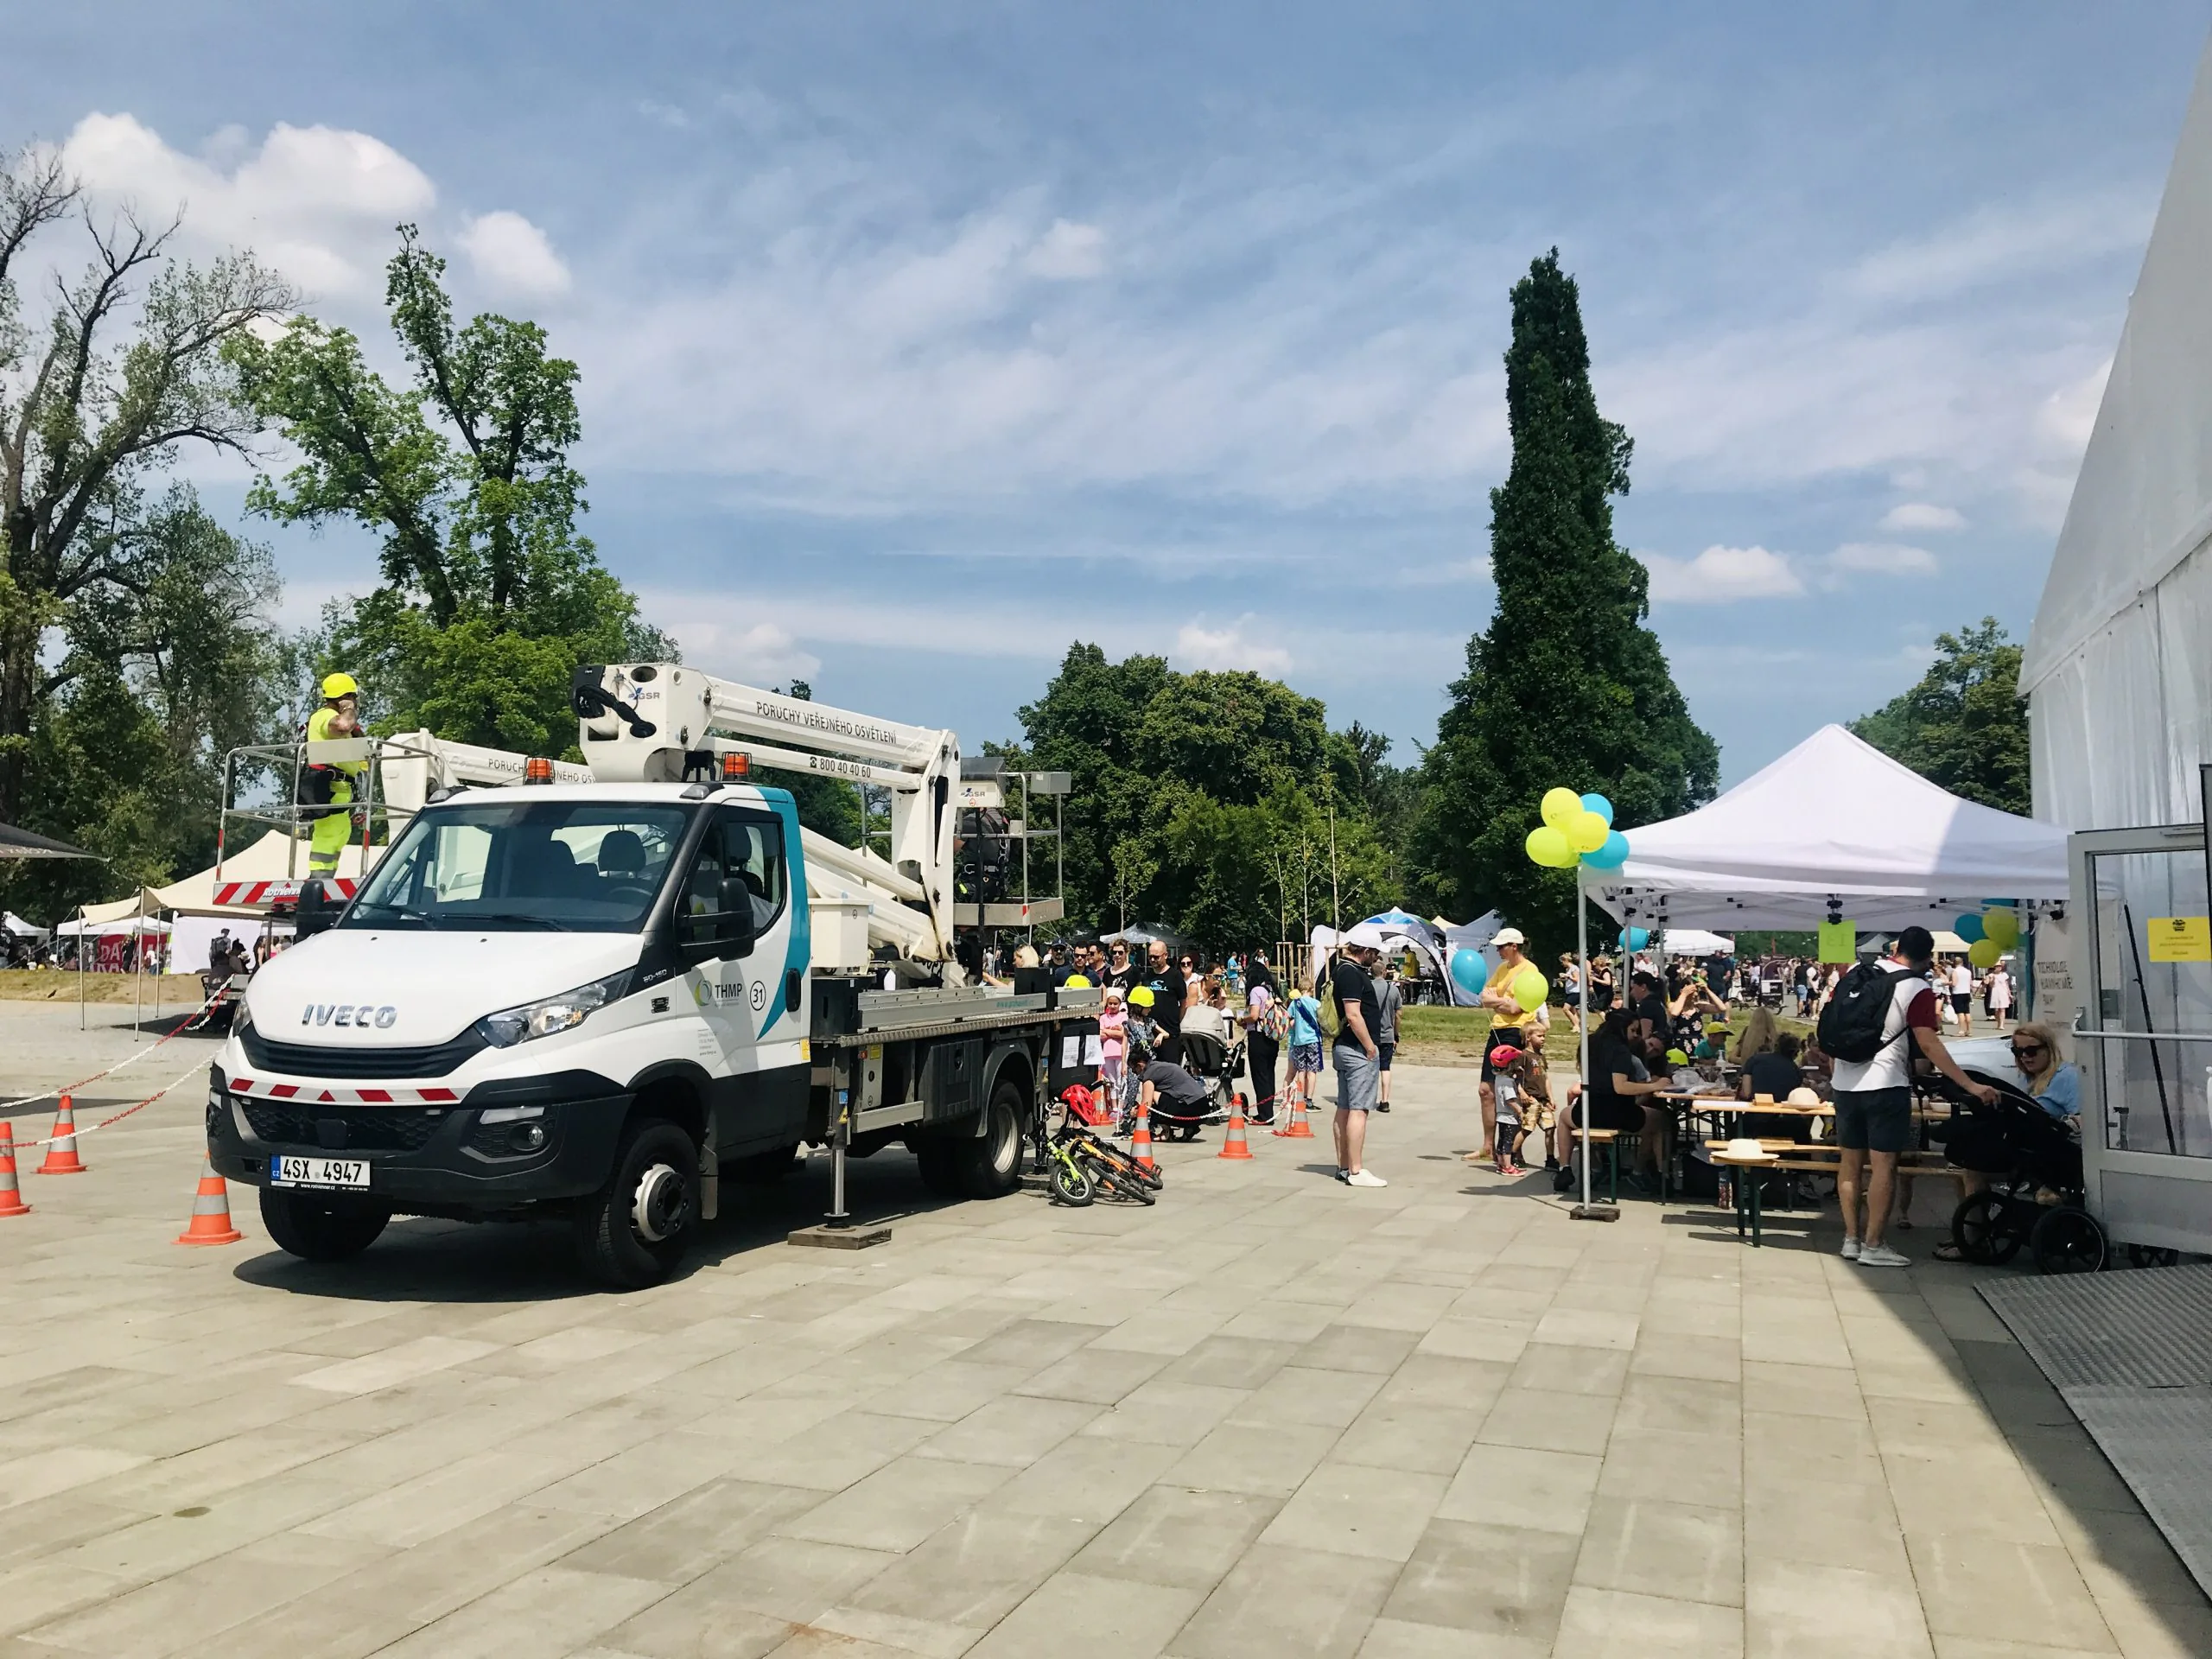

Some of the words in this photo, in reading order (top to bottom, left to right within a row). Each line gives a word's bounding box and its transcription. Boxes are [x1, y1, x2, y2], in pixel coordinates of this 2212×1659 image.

[756, 702, 801, 723] PORUCHY
[804, 712, 853, 735] VEŘEJNÉHO
[855, 725, 897, 745] OSVĚTLENÍ
[488, 759, 524, 772] PORUCH
[820, 758, 836, 772] 800
[837, 761, 848, 774] 40
[849, 764, 860, 776] 40
[861, 766, 871, 779] 60
[263, 887, 301, 898] Rothlehn
[715, 982, 743, 999] THMP
[753, 988, 764, 1003] 31
[302, 1004, 397, 1029] IVECO
[283, 1159, 310, 1180] 4SX
[322, 1161, 362, 1183] 4947
